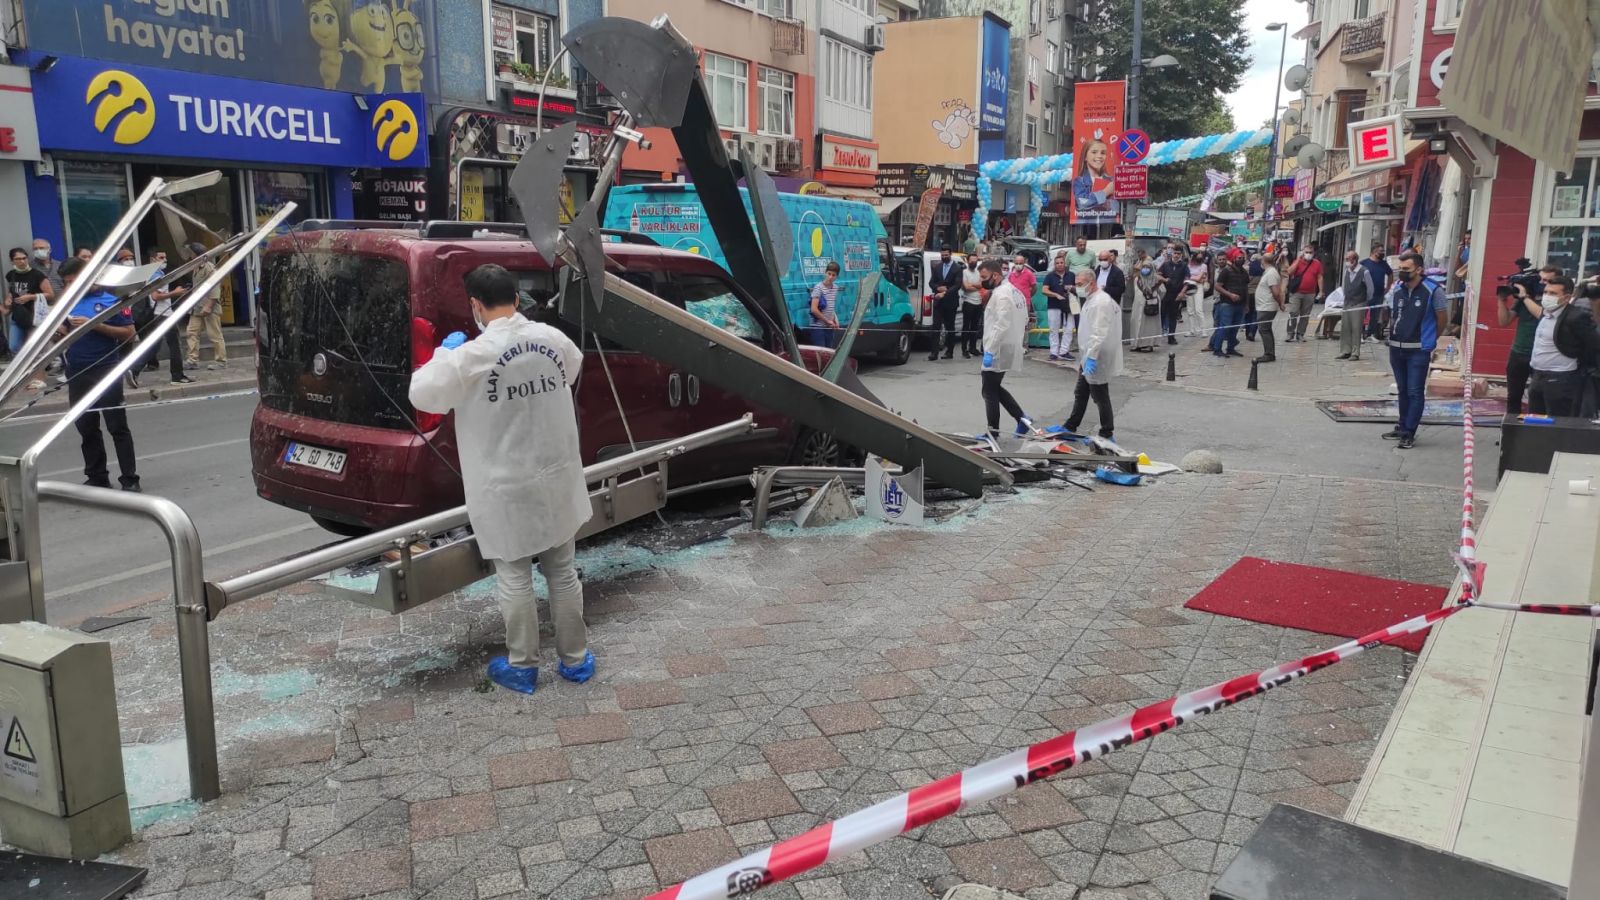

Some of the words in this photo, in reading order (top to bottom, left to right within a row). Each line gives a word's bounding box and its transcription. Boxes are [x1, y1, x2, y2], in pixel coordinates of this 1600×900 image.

[104, 4, 246, 62] hayata!
[169, 94, 341, 145] TURKCELL
[1362, 128, 1389, 161] E
[641, 222, 699, 232] VARLIKLARI
[1075, 209, 1117, 218] hepsiburada
[487, 369, 500, 403] OLAY
[496, 342, 523, 367] YERİ
[506, 374, 556, 400] POLİS
[291, 446, 305, 462] 42
[308, 449, 322, 465] GD
[323, 452, 344, 470] 748
